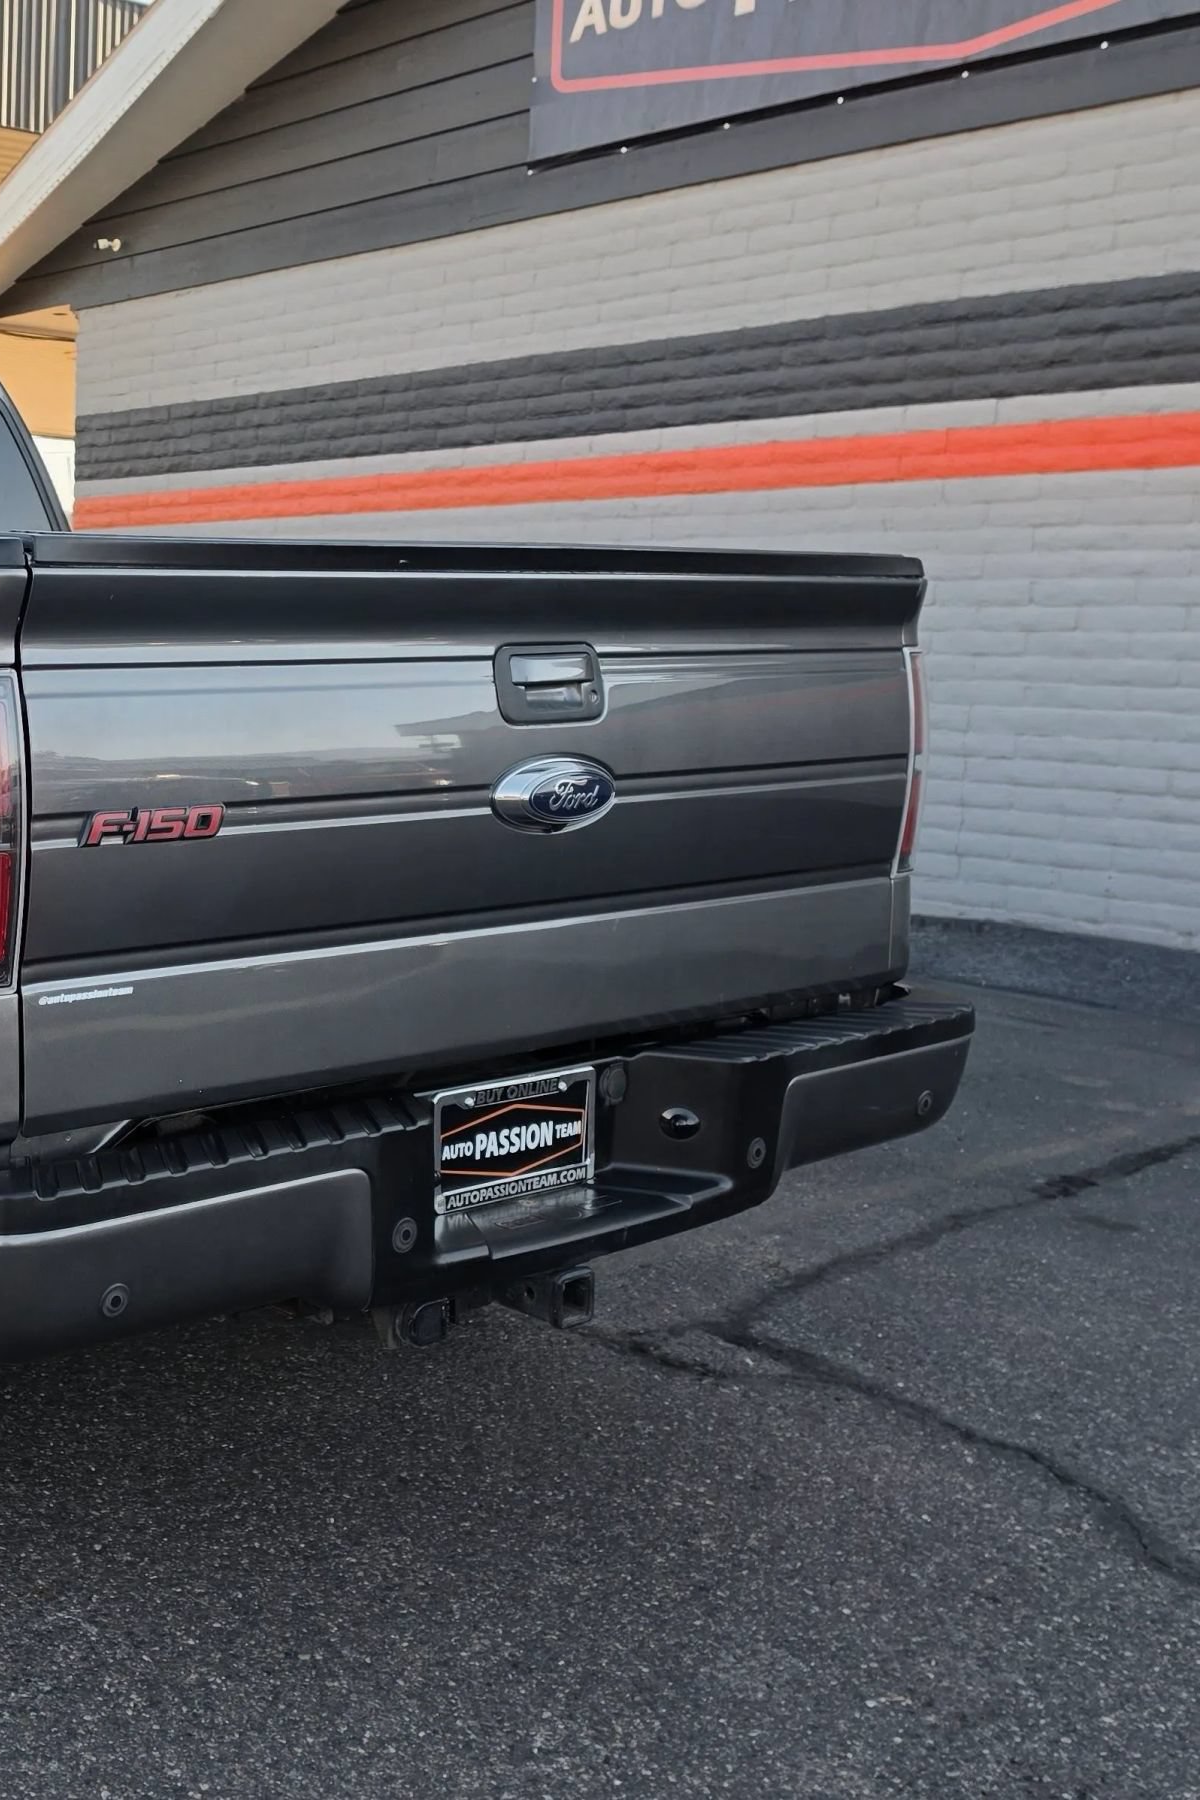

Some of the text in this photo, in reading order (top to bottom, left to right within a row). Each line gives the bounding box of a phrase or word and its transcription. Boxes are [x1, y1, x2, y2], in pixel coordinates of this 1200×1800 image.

[549, 775, 600, 812] Ford
[78, 803, 226, 848] F-150
[476, 1078, 558, 1105] BUY ONLINE
[441, 1120, 582, 1161] AUTO PASSION TEAM
[446, 1166, 586, 1209] AUTOPASSIONTEAM.COM
